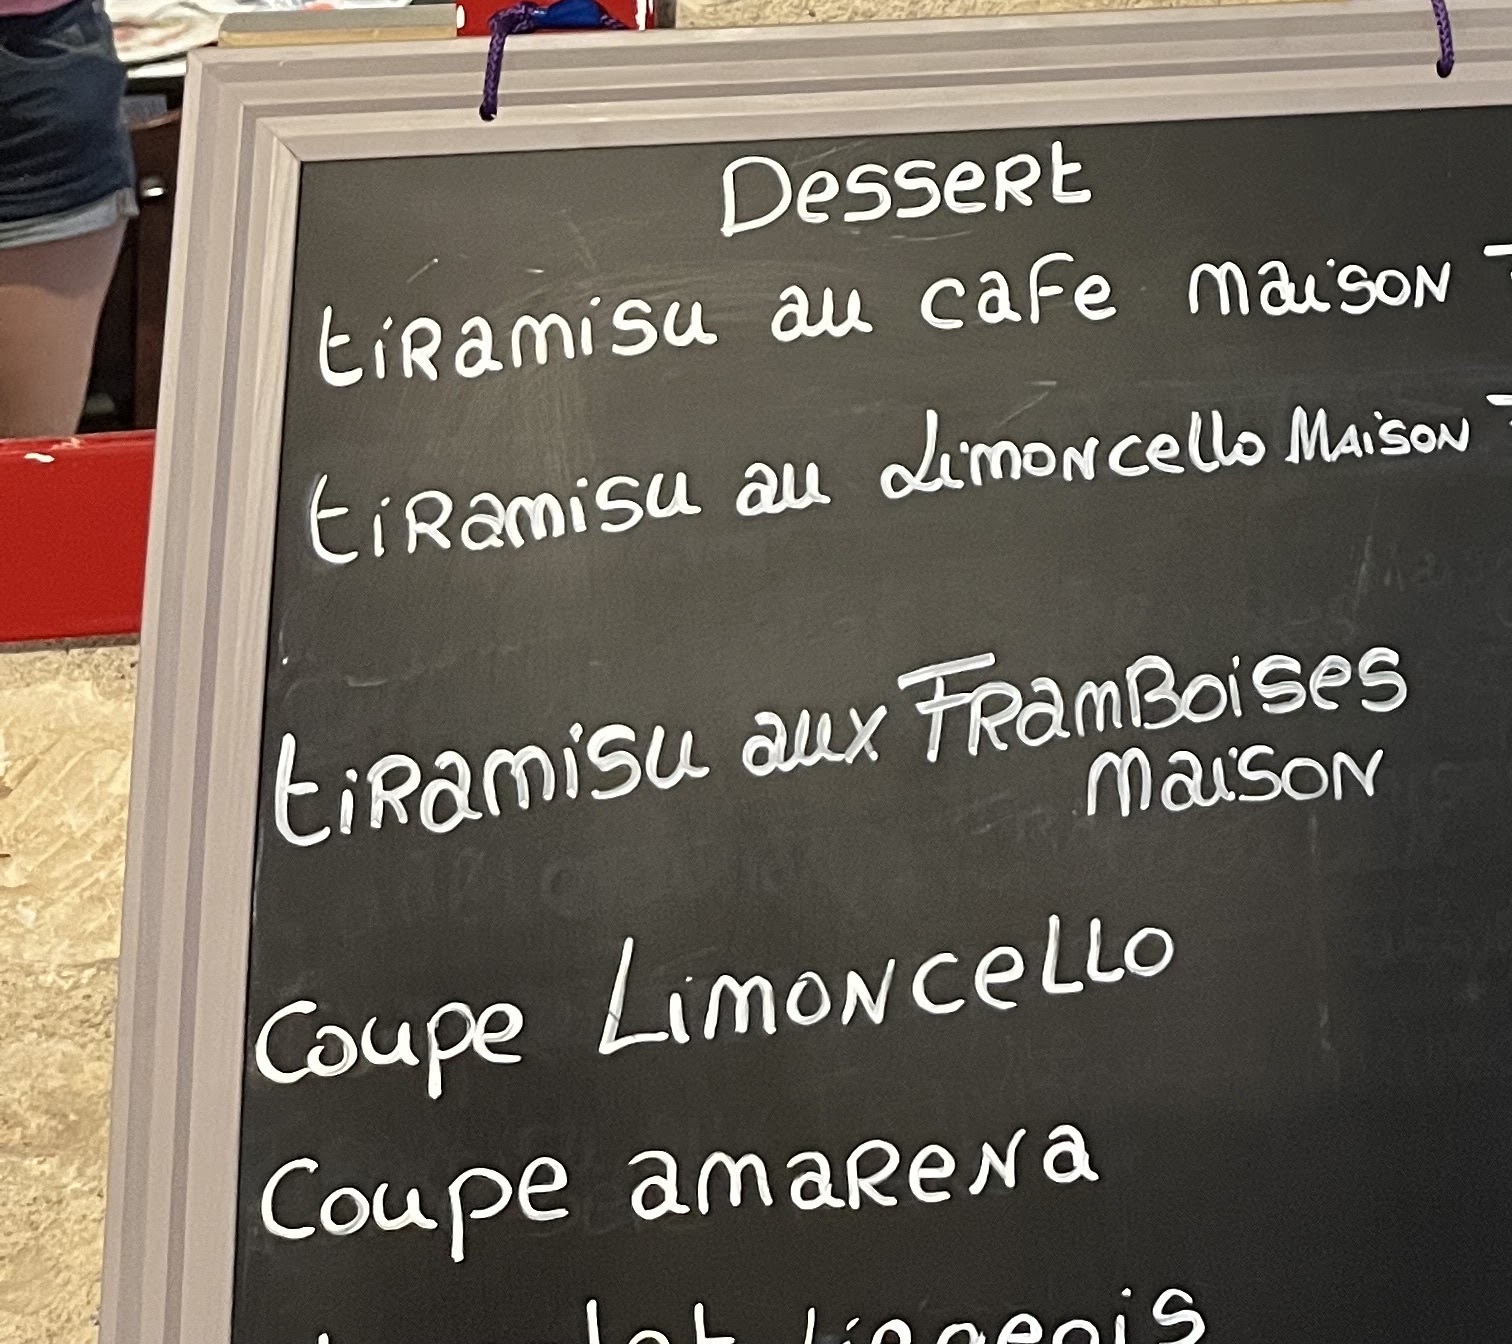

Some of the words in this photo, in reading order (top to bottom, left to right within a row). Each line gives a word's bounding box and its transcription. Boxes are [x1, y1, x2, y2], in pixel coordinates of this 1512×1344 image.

[769, 283, 875, 344] au
[734, 461, 833, 518] au
[740, 703, 889, 778] aux
[254, 999, 525, 1101] Coupe
[259, 1155, 570, 1264] Coupe
